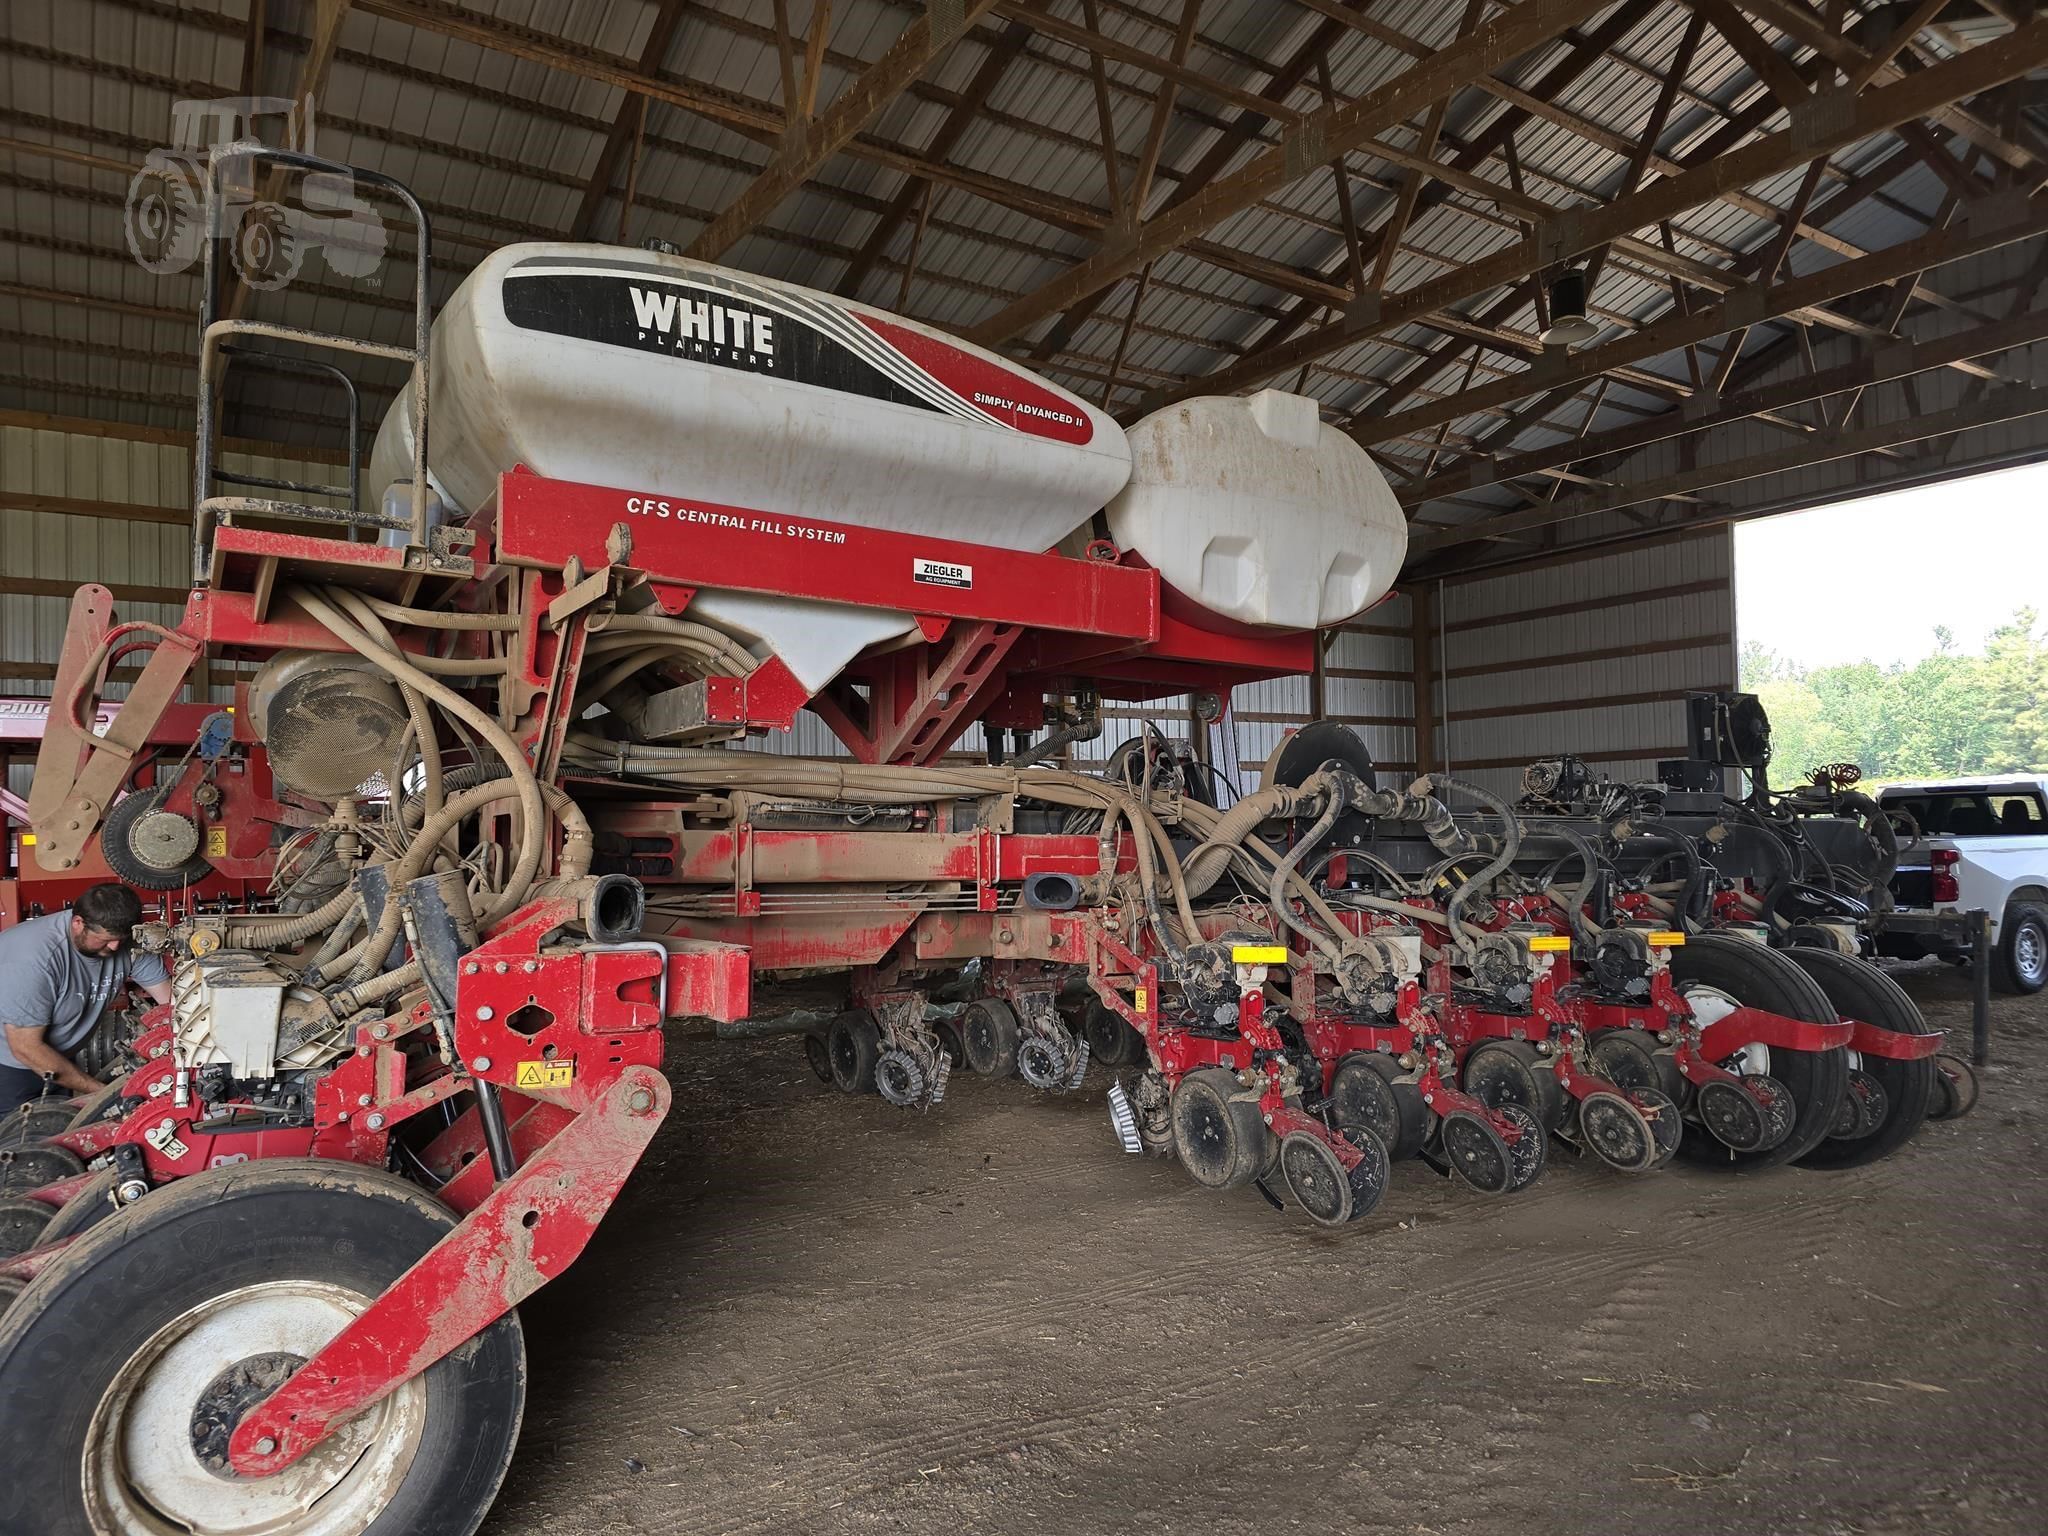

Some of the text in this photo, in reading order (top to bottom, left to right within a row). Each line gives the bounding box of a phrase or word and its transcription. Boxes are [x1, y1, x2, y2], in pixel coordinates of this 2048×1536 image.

[629, 287, 774, 355] WHITE
[638, 331, 774, 368] PLANTERS
[974, 392, 1083, 427] SIMPLY ADVANCED II
[626, 497, 846, 545] CFS CENTRAL FILL SYSTEM
[923, 563, 963, 578] ZIEGLER
